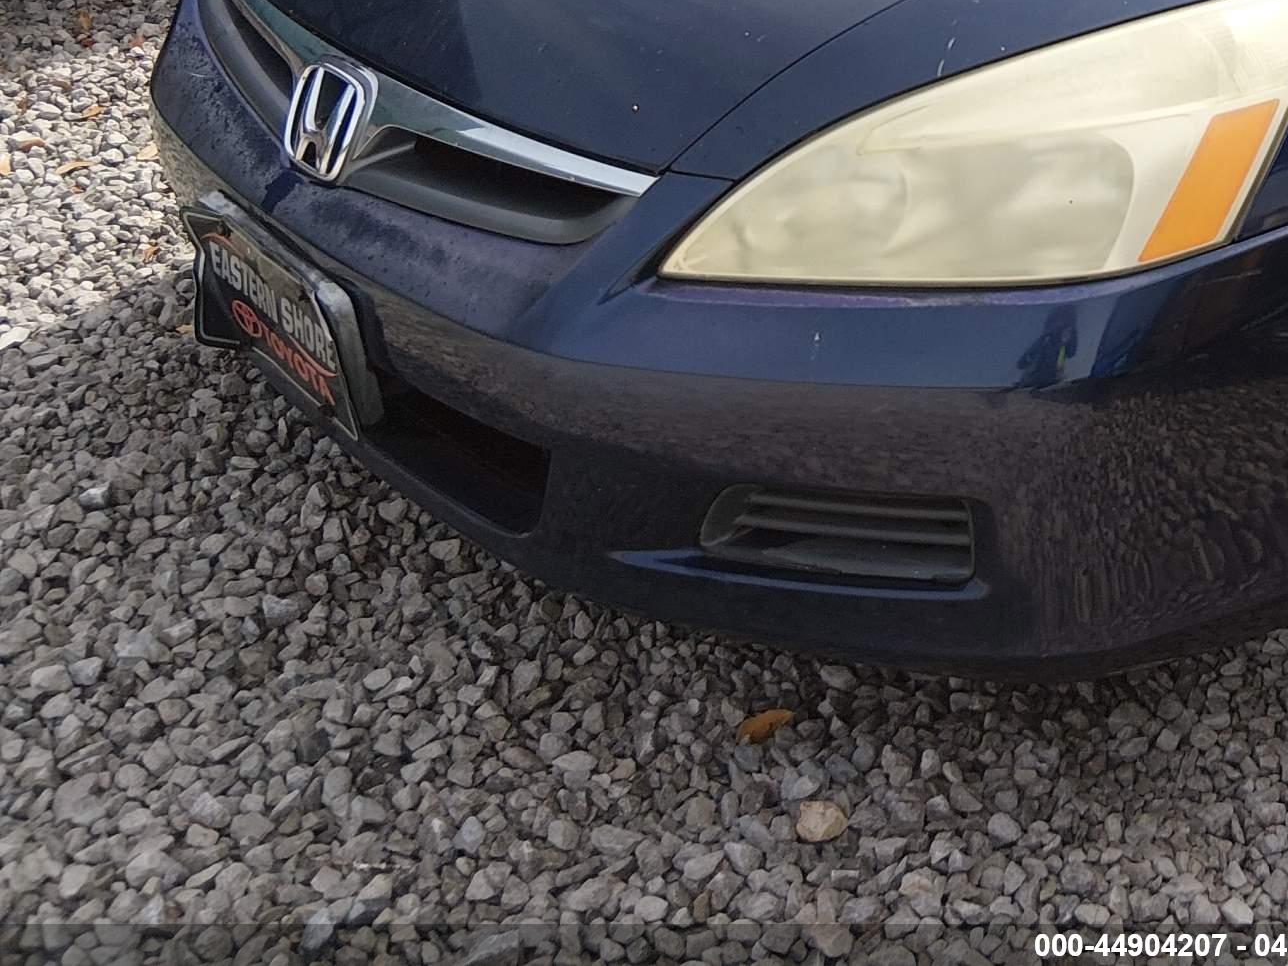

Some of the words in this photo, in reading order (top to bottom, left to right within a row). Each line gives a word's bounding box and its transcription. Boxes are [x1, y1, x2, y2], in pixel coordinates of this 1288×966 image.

[209, 240, 278, 325] EASTERN
[280, 297, 337, 372] SHORE
[260, 320, 336, 406] TOYOTA
